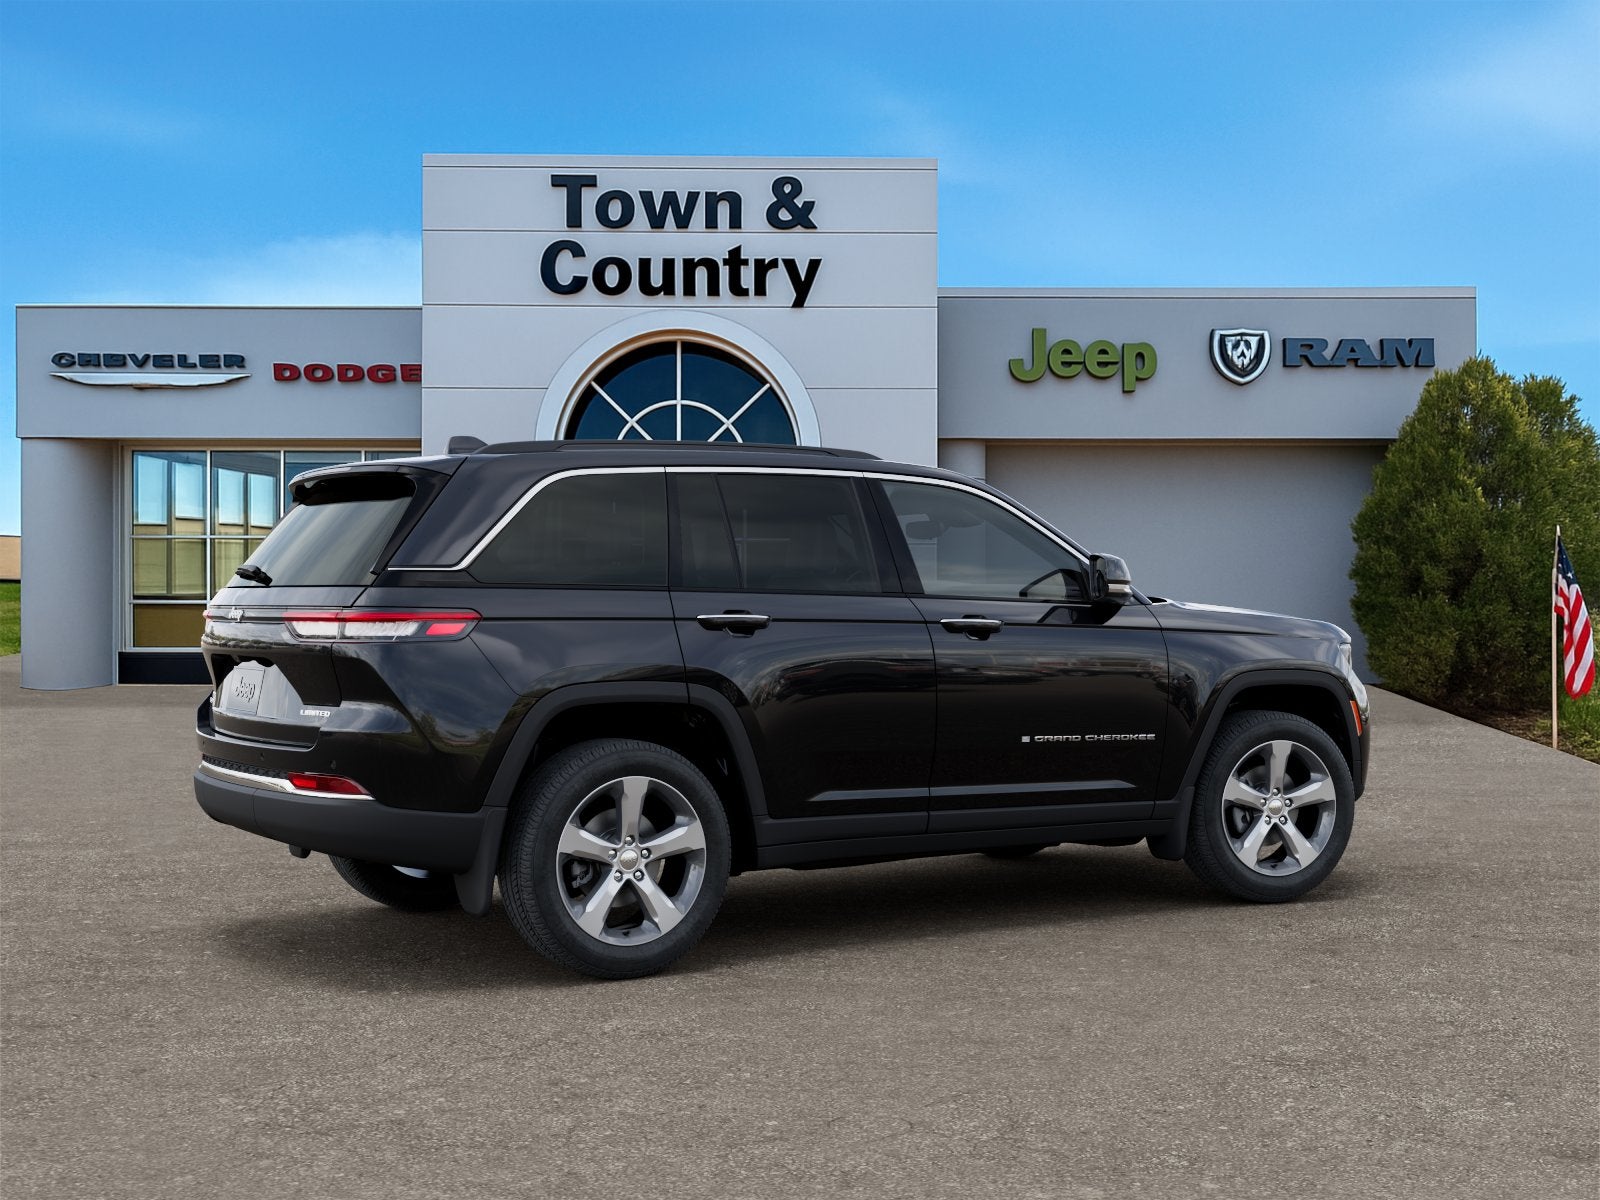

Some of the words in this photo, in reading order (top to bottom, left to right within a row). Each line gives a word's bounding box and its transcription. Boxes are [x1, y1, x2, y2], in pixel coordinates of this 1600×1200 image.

[550, 174, 742, 230] Town
[765, 176, 818, 230] &
[540, 239, 822, 308] Country
[1009, 328, 1157, 393] Jeep
[1283, 337, 1436, 368] RAM
[273, 363, 422, 383] DODGE
[300, 709, 331, 717] LIMITED
[1084, 733, 1156, 741] CHEROKEE
